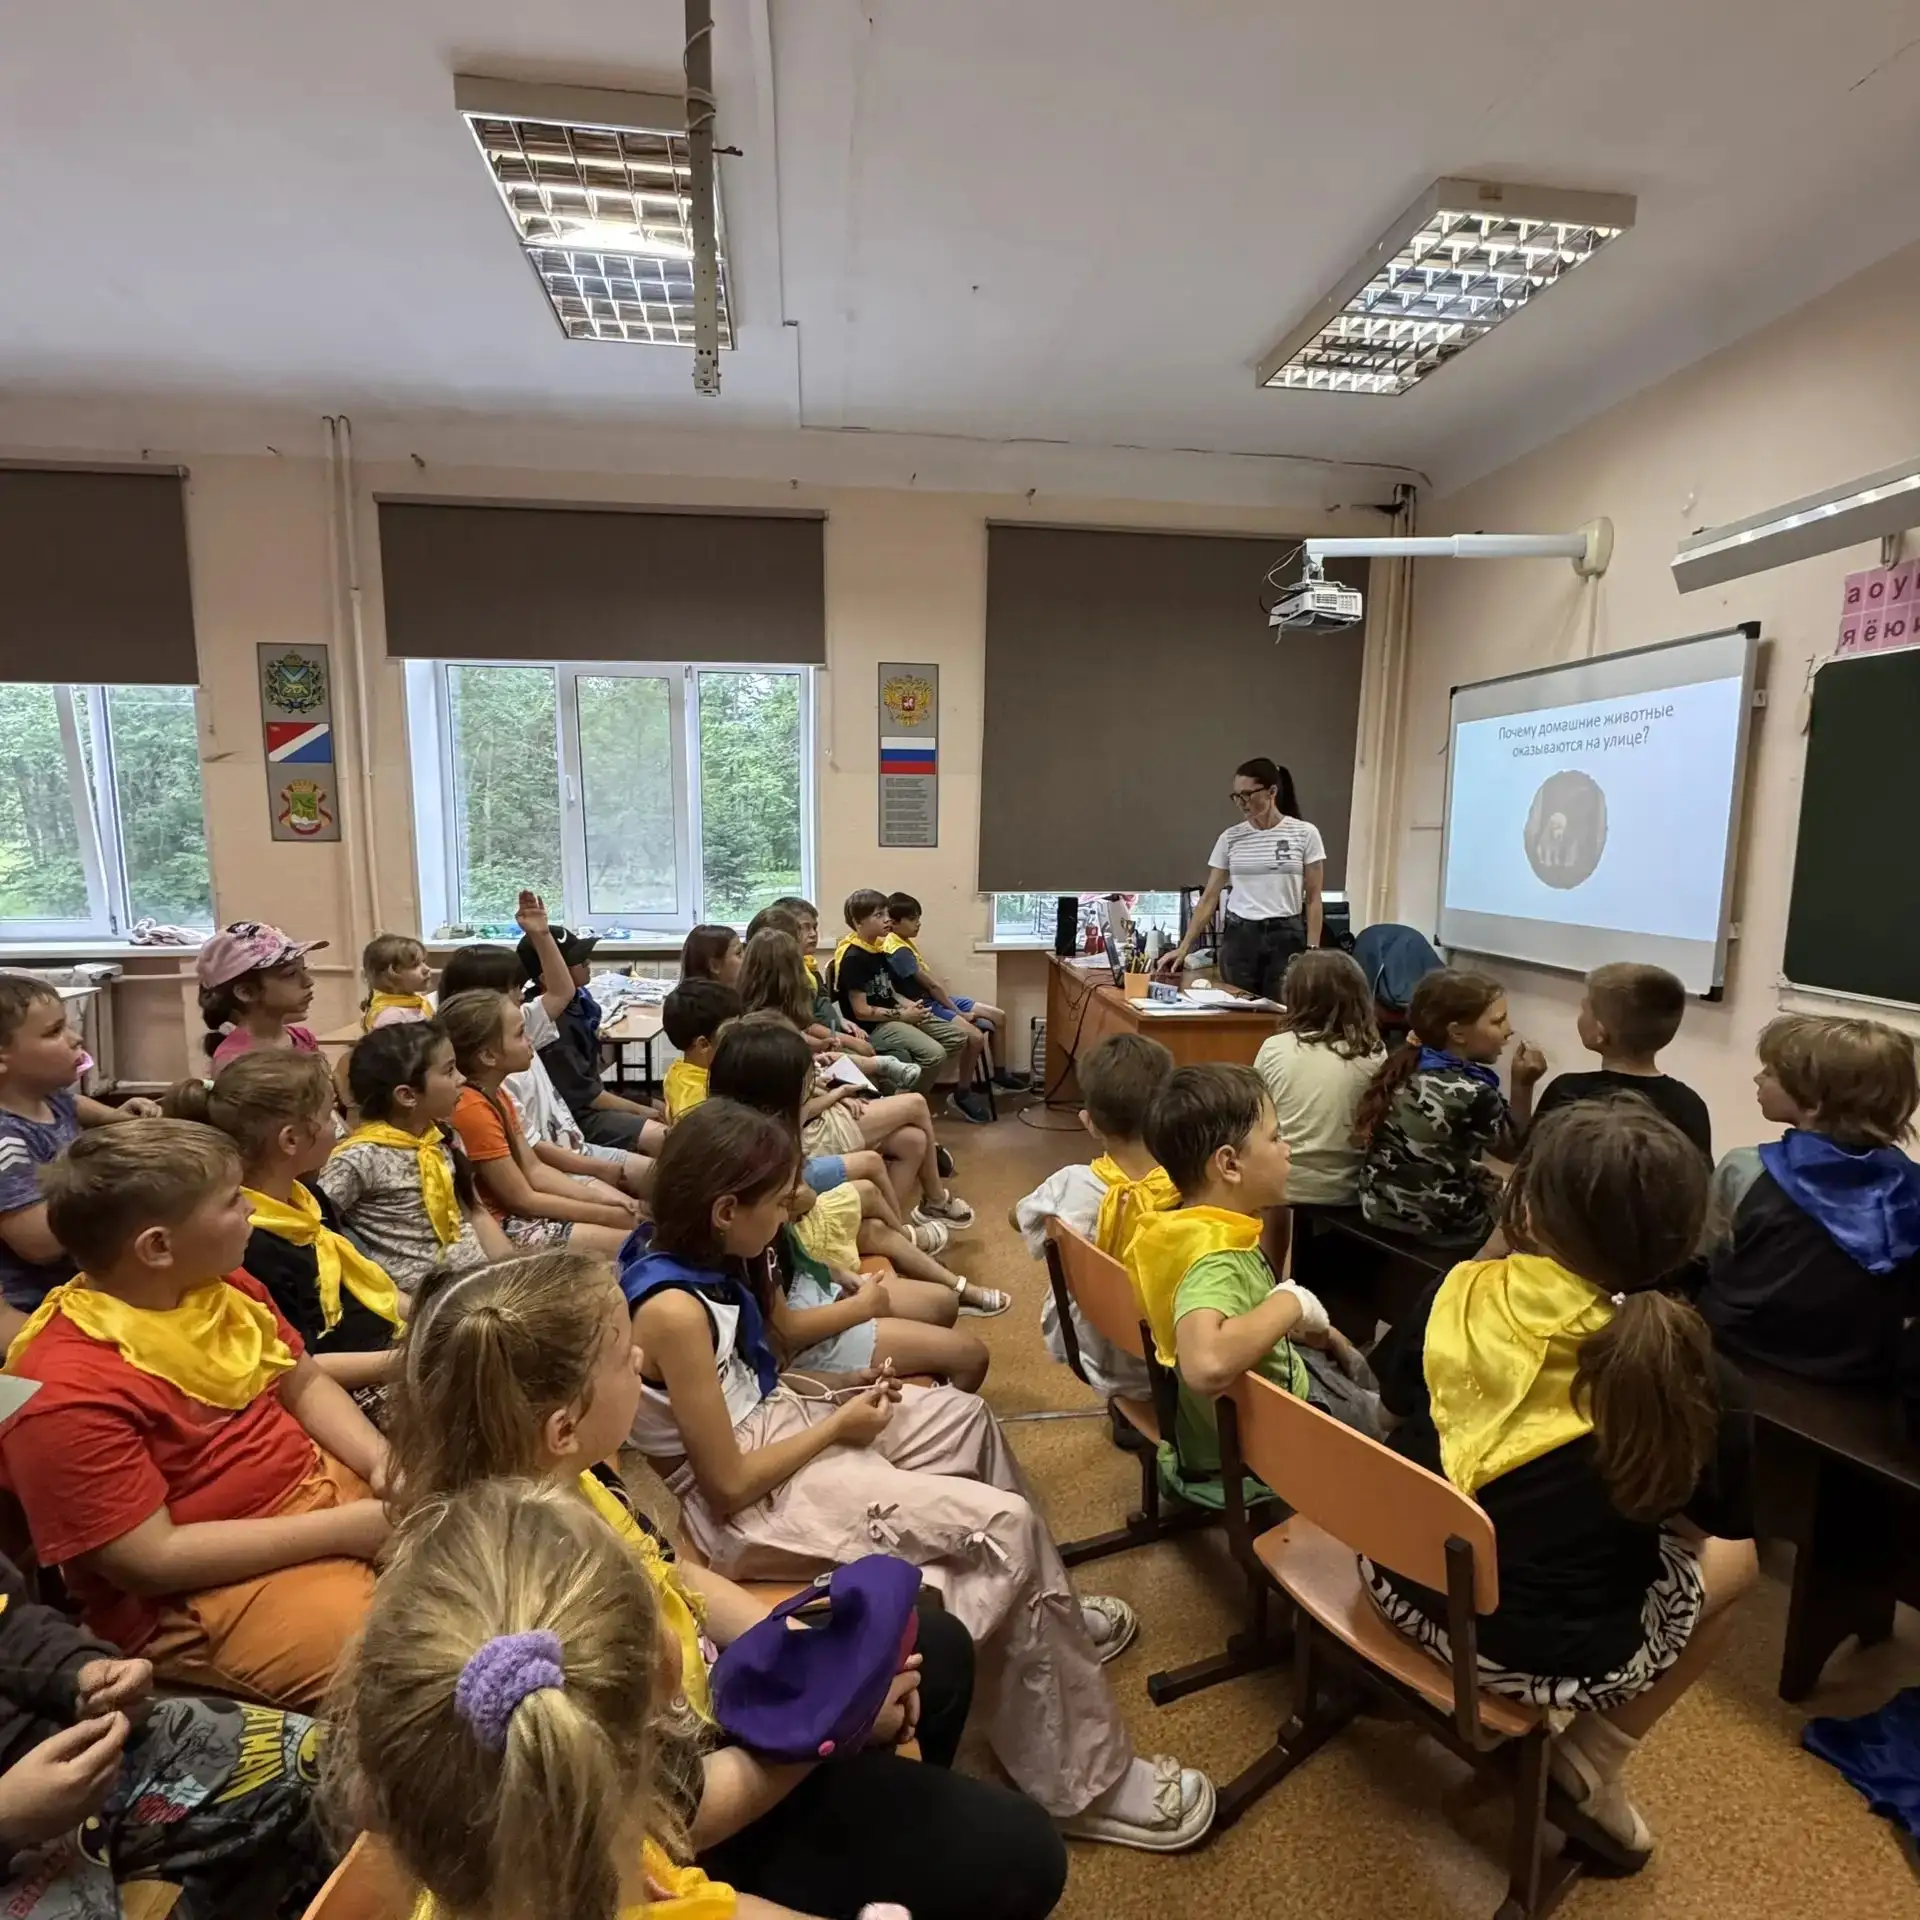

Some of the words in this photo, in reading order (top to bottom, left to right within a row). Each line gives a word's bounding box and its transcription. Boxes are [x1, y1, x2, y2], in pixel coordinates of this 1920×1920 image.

[1498, 726, 1537, 741] Почему
[1538, 716, 1601, 737] домашние
[1603, 704, 1675, 727] животные
[1512, 740, 1583, 758] оказываются
[1585, 738, 1600, 749] на
[1603, 725, 1650, 751] улице?
[212, 1700, 285, 1805] ATMAN
